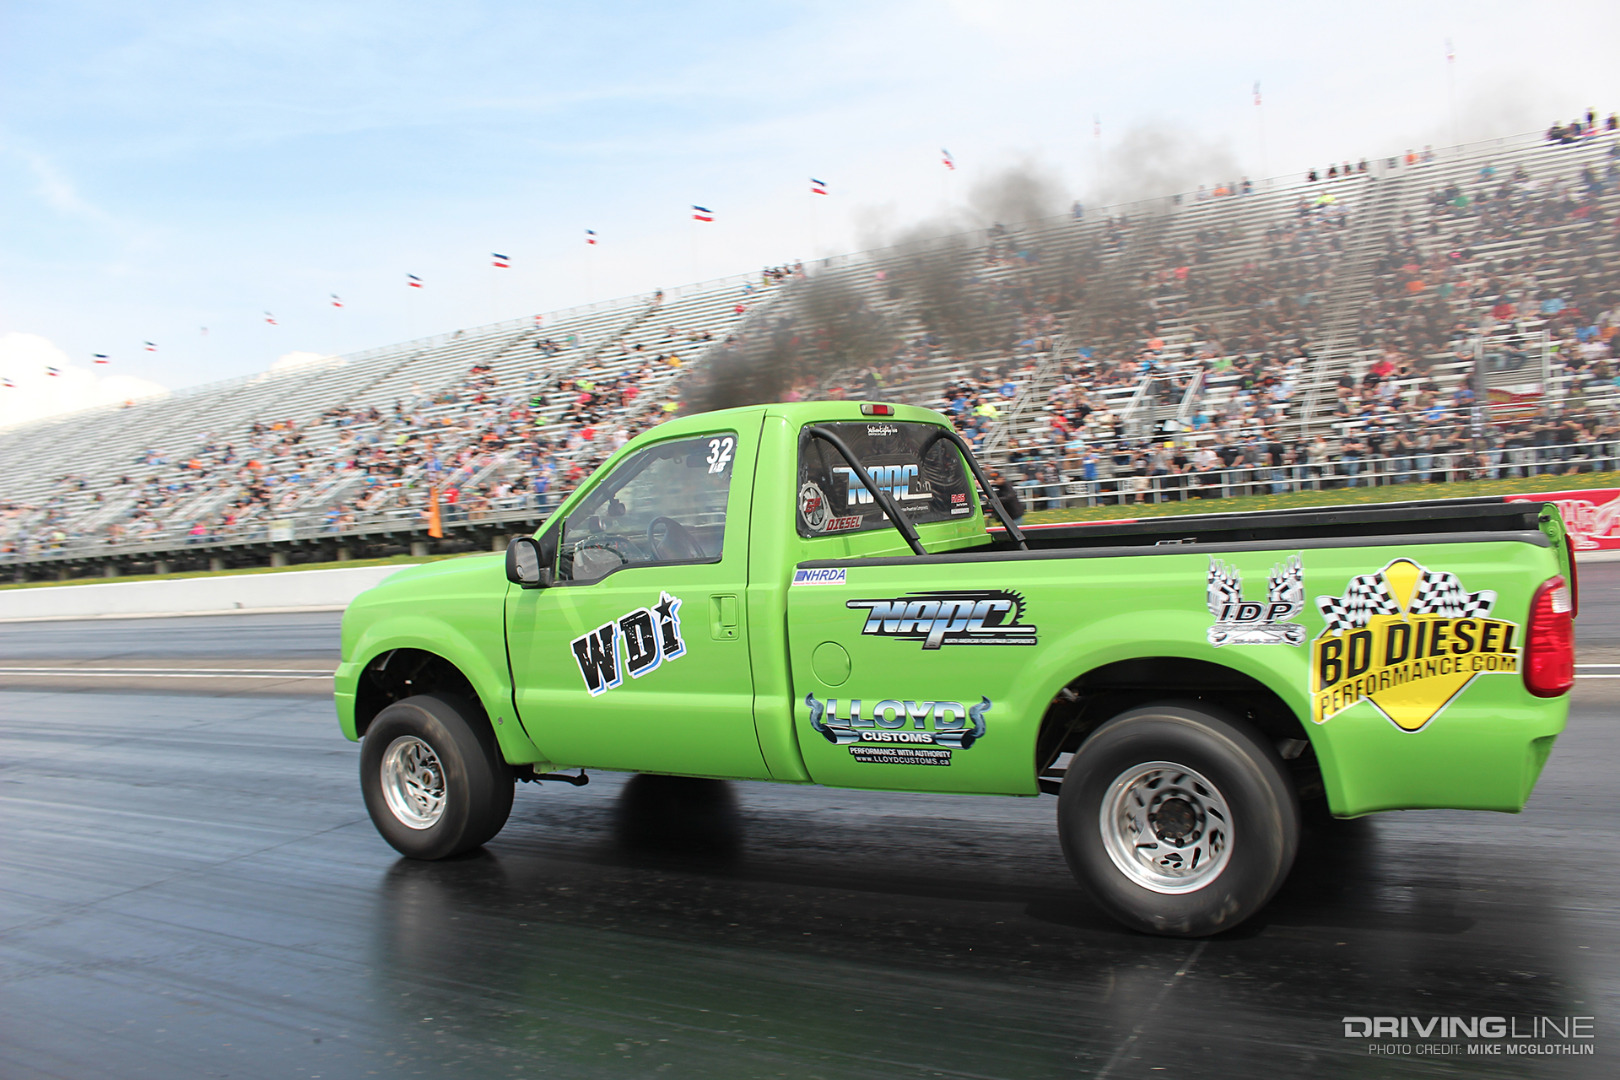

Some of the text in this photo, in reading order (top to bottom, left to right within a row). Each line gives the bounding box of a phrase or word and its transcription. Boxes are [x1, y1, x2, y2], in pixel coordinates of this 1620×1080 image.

[706, 437, 733, 464] 32
[826, 516, 860, 531] DIESEL
[801, 569, 846, 581] NHRDA
[1320, 620, 1517, 690] BD DIESEL
[827, 699, 965, 728] LLOYD
[862, 732, 932, 743] CUSTOMS
[849, 747, 951, 758] PERFORMANCE WITH AUTHORITY
